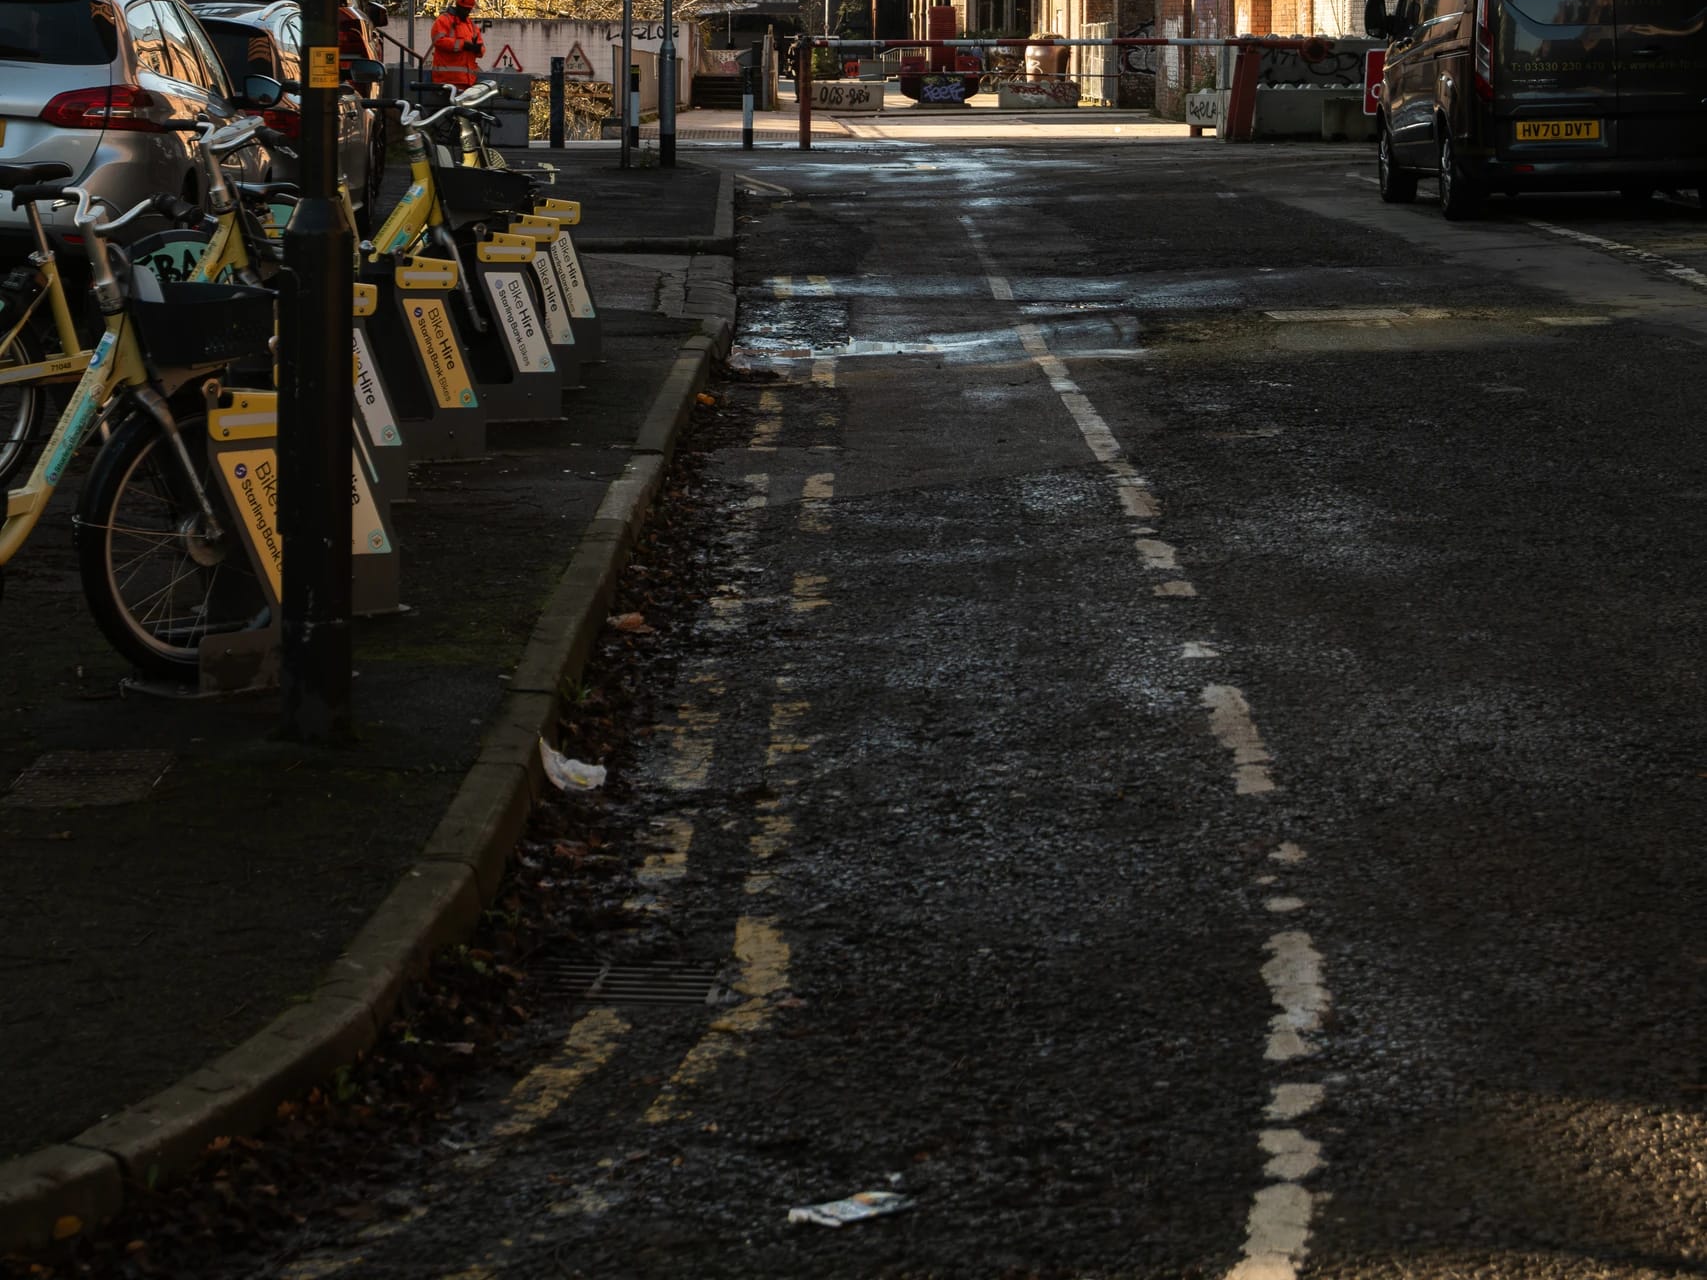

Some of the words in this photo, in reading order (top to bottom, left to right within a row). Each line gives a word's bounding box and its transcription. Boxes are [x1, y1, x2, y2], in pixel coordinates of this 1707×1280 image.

[1524, 62, 1558, 72] 03330
[1521, 123, 1560, 137] HV70
[1564, 122, 1593, 136] DVT
[536, 258, 550, 286] Bike
[545, 284, 558, 313] Hire
[559, 237, 571, 263] Bike
[566, 261, 579, 288] Hire
[507, 279, 524, 310] Bike
[519, 308, 535, 338] Hire
[417, 317, 434, 355] Starling
[430, 352, 444, 379] Bank
[427, 307, 444, 340] Bike
[439, 338, 455, 370] Hire
[357, 370, 376, 406] Hire
[241, 477, 267, 530] Starling
[261, 524, 283, 566] Bank
